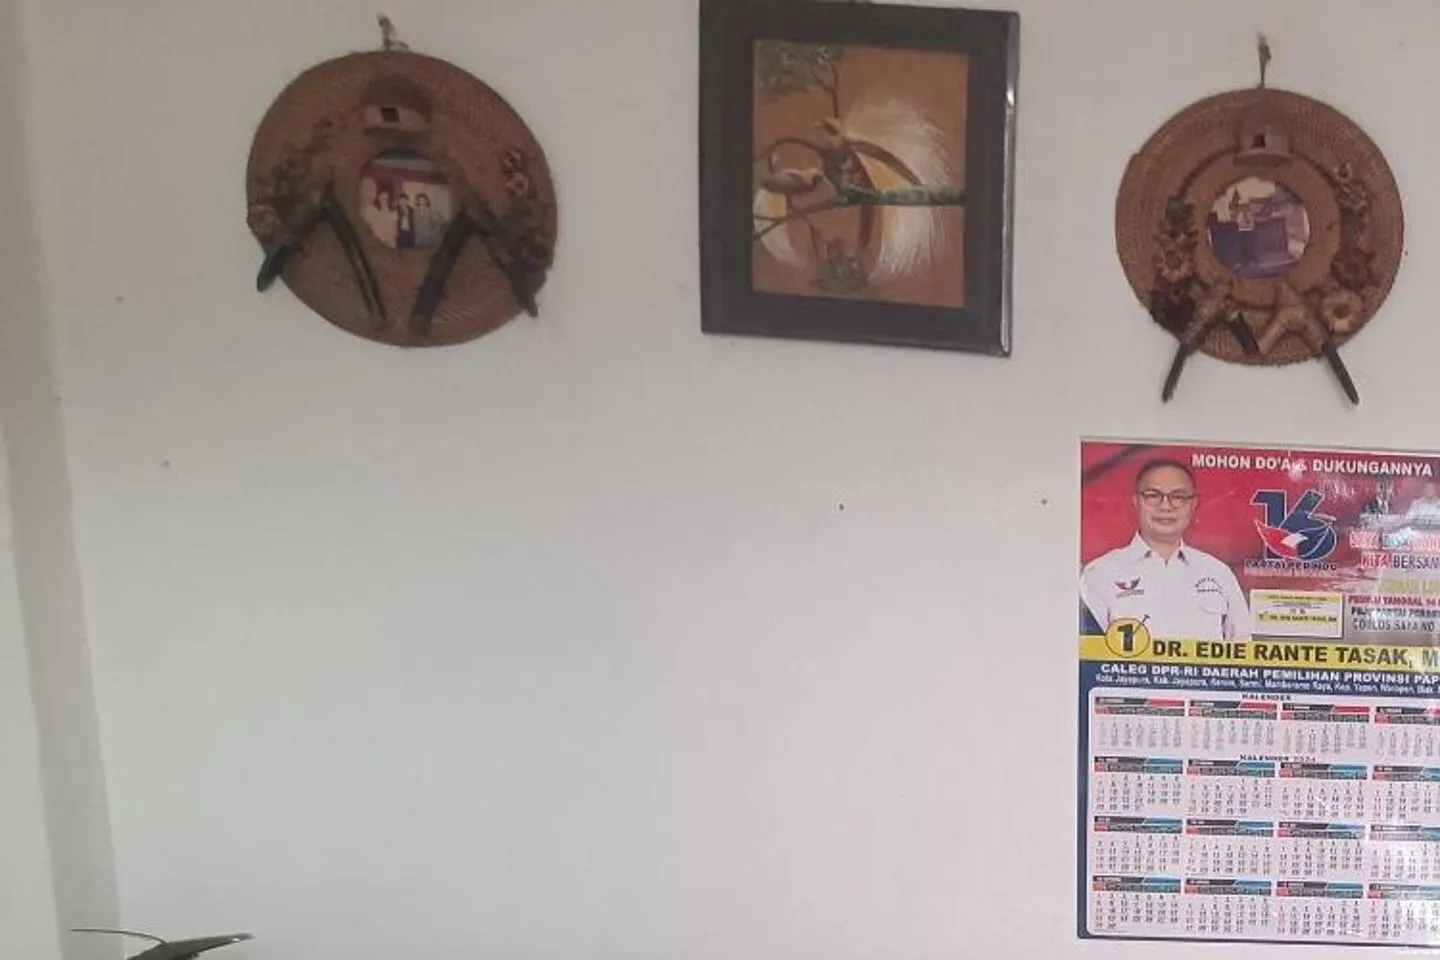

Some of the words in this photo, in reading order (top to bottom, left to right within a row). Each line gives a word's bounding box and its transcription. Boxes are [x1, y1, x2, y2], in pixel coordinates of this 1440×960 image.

[1192, 454, 1250, 469] MOHON
[1255, 456, 1291, 470] DO'A
[1312, 459, 1433, 477] DUKUNGANNYA
[1117, 624, 1134, 652] 1
[1153, 642, 1188, 658] DR.
[1196, 642, 1246, 659] EDIE
[1253, 643, 1328, 662] RANTE
[1335, 647, 1413, 669] TASAK,
[1101, 663, 1147, 675] CALEG
[1152, 665, 1198, 677] DPR-RI
[1202, 667, 1259, 679] DAERAH
[1263, 669, 1340, 682] PEMILIHAN
[1344, 671, 1409, 684] PROVINSI
